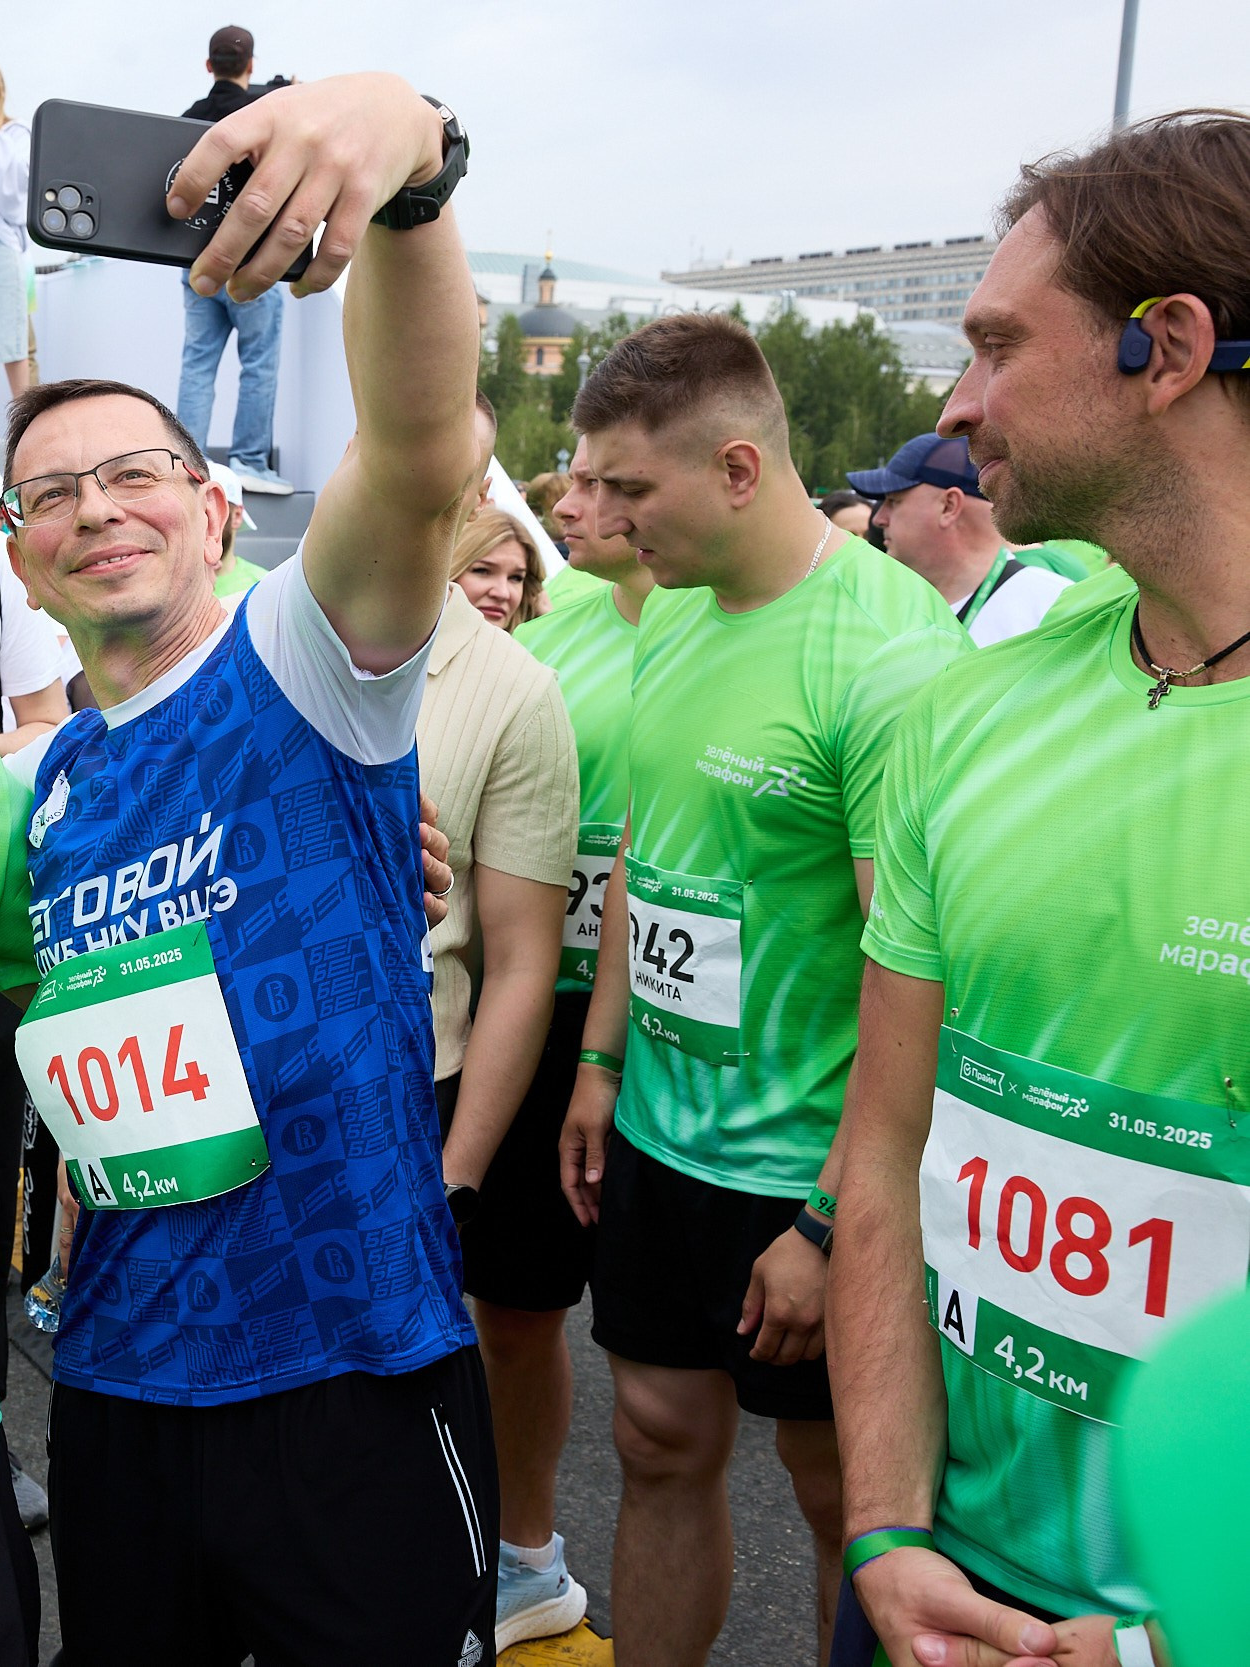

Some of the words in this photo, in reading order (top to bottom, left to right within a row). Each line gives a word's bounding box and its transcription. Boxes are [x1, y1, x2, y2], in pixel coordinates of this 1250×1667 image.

[694, 758, 754, 789] марафон
[704, 744, 765, 774] зелёный
[278, 780, 333, 815] БЕГ
[281, 800, 338, 833] БЕГ
[285, 818, 343, 852] БЕГ
[289, 838, 346, 870] БЕГ
[28, 811, 224, 947] ЕГОВОЙ
[671, 886, 720, 903] 31.05.2025
[157, 875, 239, 933] ВШЭ
[300, 872, 351, 938] БЕГ
[119, 947, 183, 976] 31.05.2025
[309, 933, 364, 966] БЕГ
[312, 952, 367, 984] БЕГ
[317, 969, 369, 1002] БЕГ
[635, 969, 683, 1002] НИКИТА
[320, 987, 372, 1019] БЕГ
[330, 1014, 380, 1080] БЕГ
[46, 1024, 210, 1126] 1014
[971, 1067, 997, 1087] Прайм
[340, 1078, 386, 1106] БЕГ
[342, 1094, 389, 1123] БЕГ
[1021, 1091, 1064, 1114] марафон
[1028, 1083, 1070, 1104] зелёный
[346, 1111, 391, 1140] БЕГ
[1108, 1112, 1213, 1150] 31.05.2025
[349, 1128, 394, 1157] БЕГ
[87, 1163, 112, 1201] A
[356, 1152, 400, 1222] БЕГ
[363, 1217, 414, 1250] БЕГ
[956, 1155, 1174, 1319] 1081
[943, 1288, 966, 1345] A
